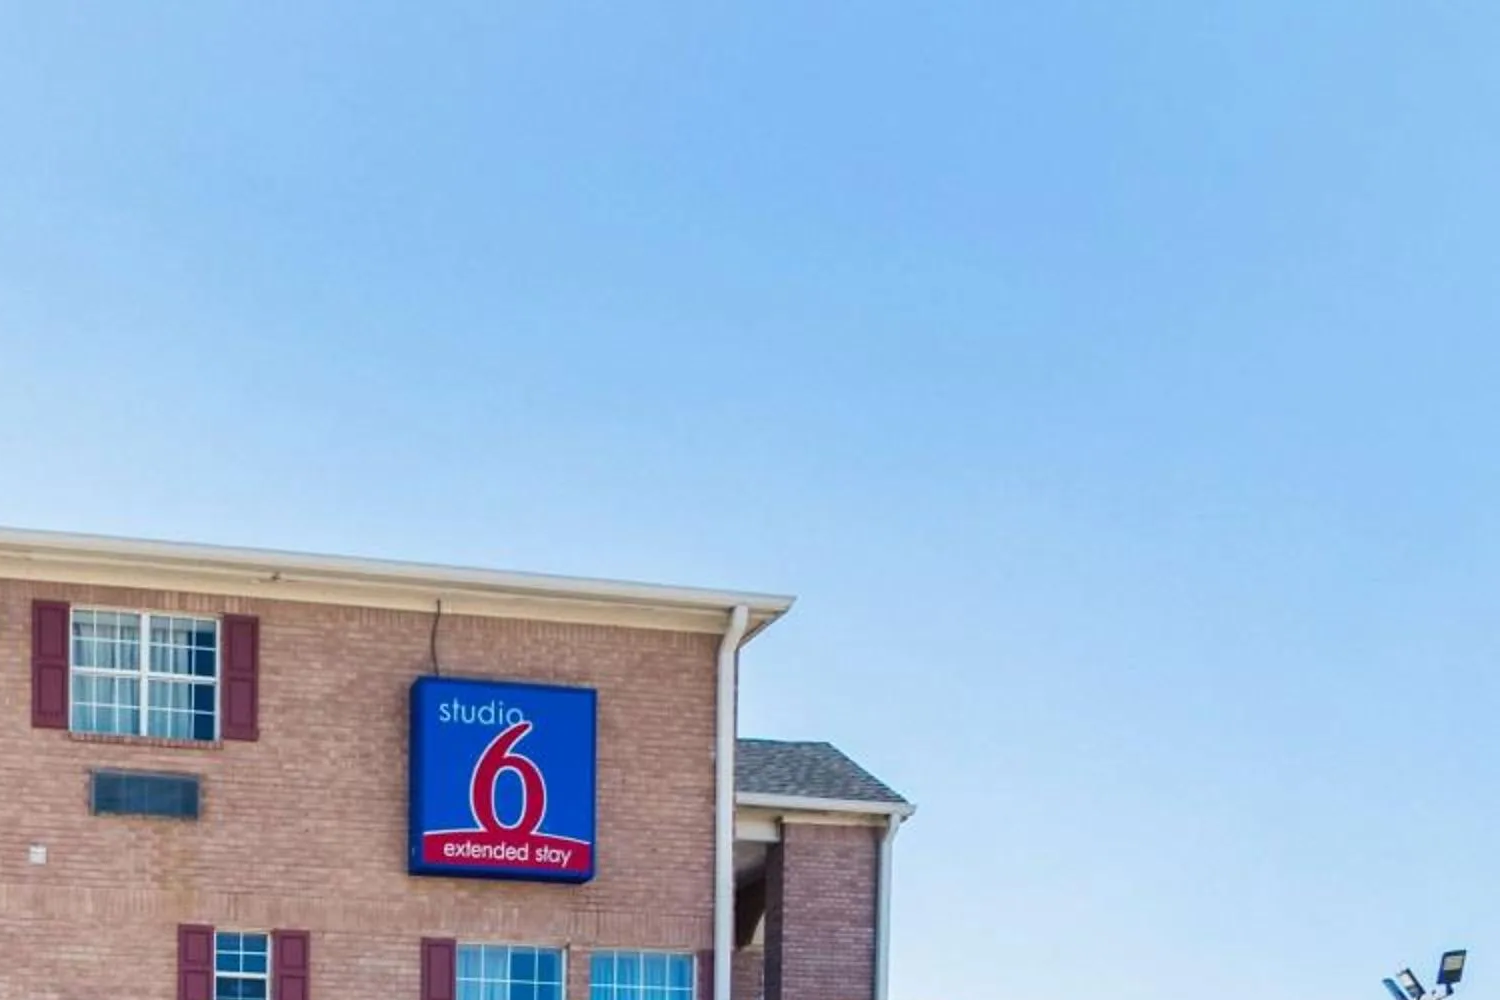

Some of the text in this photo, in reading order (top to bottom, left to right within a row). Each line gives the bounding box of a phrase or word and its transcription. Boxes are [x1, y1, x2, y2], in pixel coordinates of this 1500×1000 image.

[438, 698, 524, 726] studio
[469, 720, 547, 830] 6
[443, 840, 572, 868] extended stay
